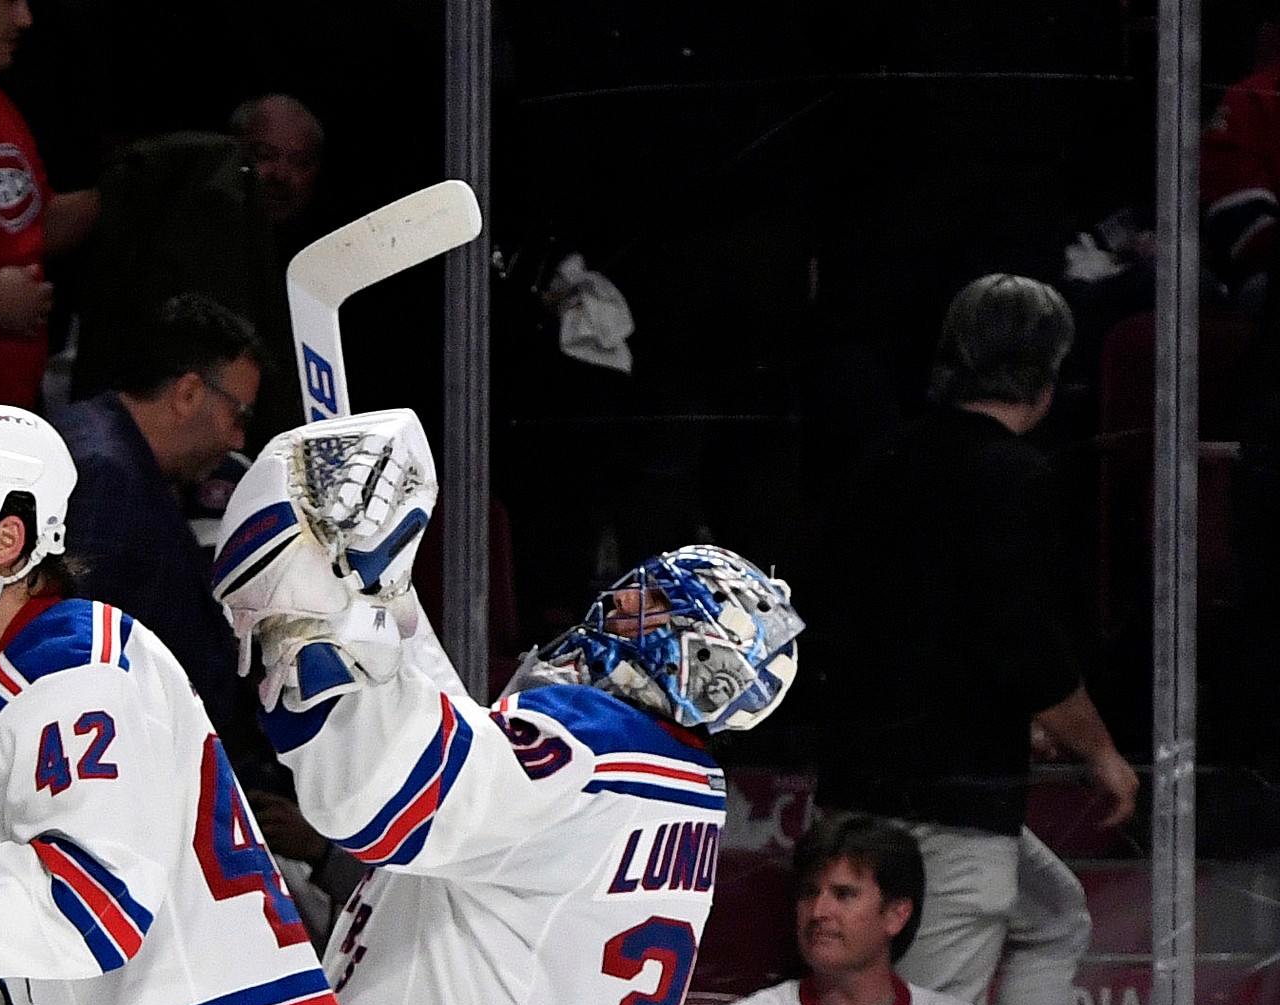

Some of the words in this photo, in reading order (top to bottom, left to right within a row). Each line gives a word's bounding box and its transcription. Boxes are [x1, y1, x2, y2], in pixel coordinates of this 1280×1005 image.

[302, 341, 338, 421] B
[35, 710, 119, 797] 42
[193, 732, 312, 949] 4
[606, 821, 719, 895] LUND
